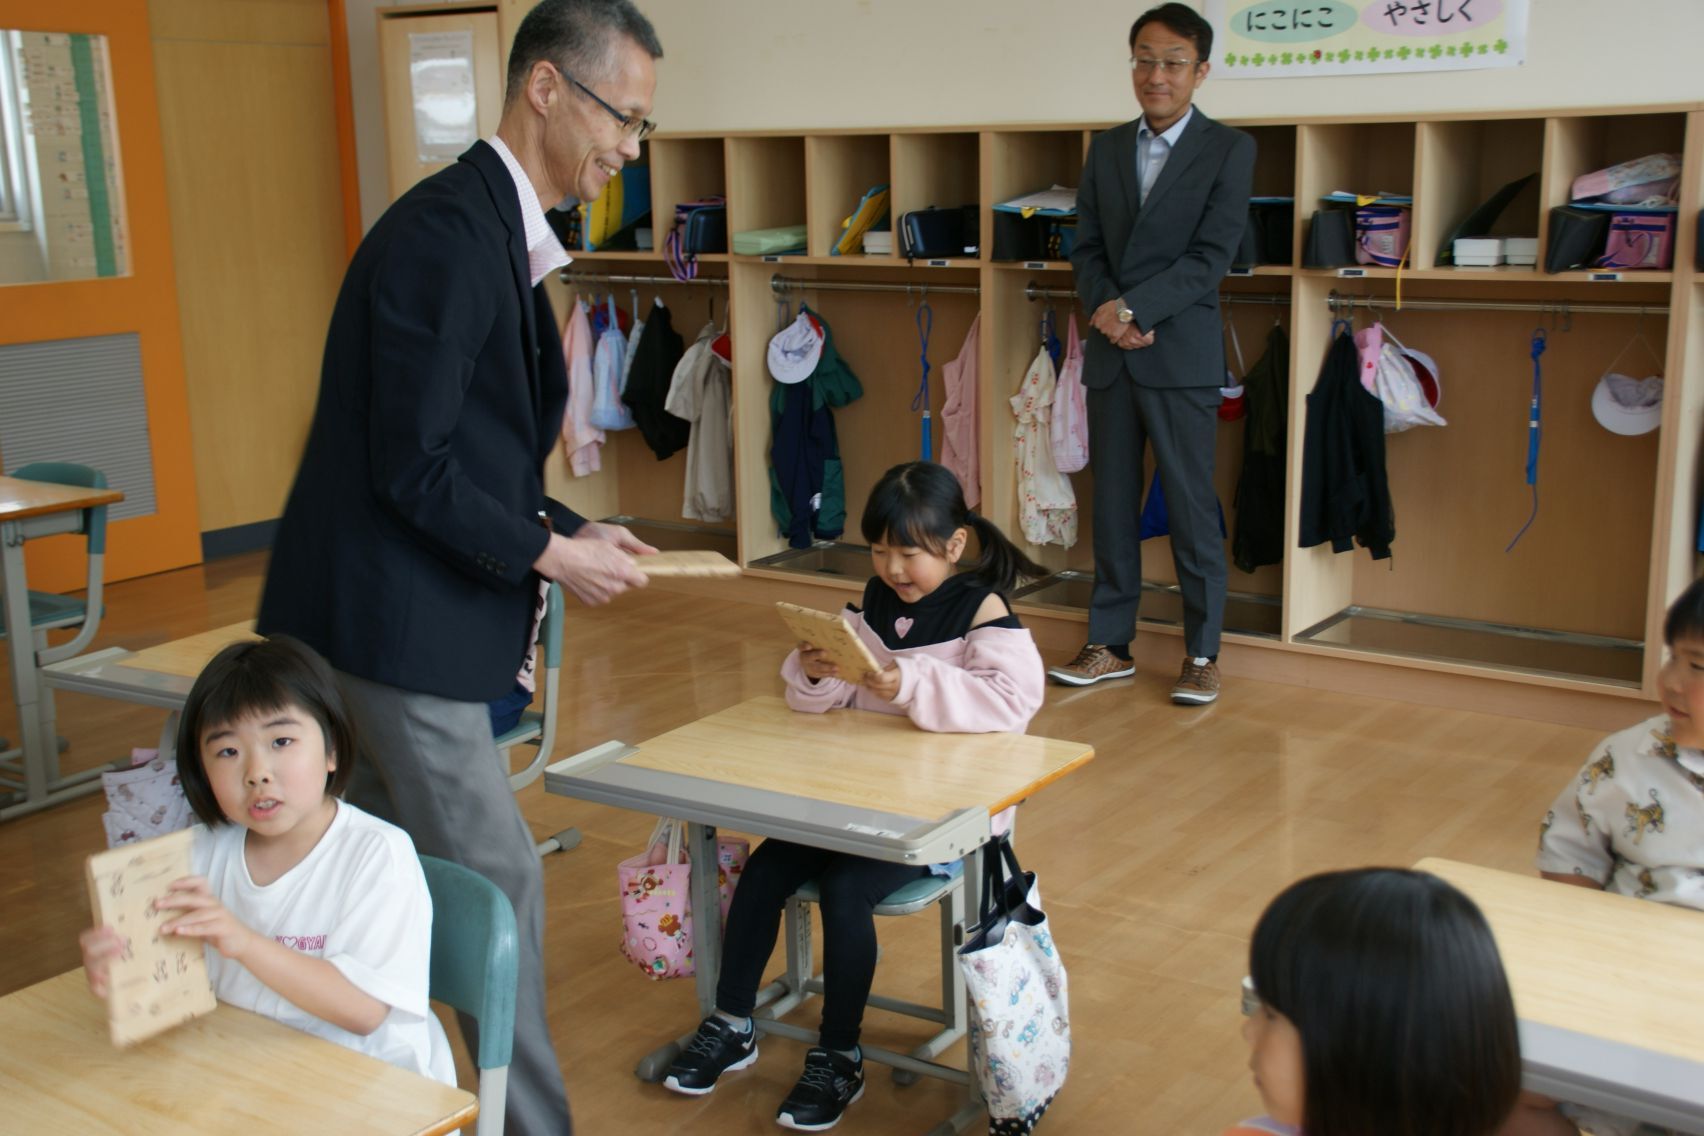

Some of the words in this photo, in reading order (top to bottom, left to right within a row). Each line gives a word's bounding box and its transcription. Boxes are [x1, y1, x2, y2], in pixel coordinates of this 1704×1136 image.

[1247, 7, 1333, 32] にこにこ
[1384, 0, 1472, 26] やさしく
